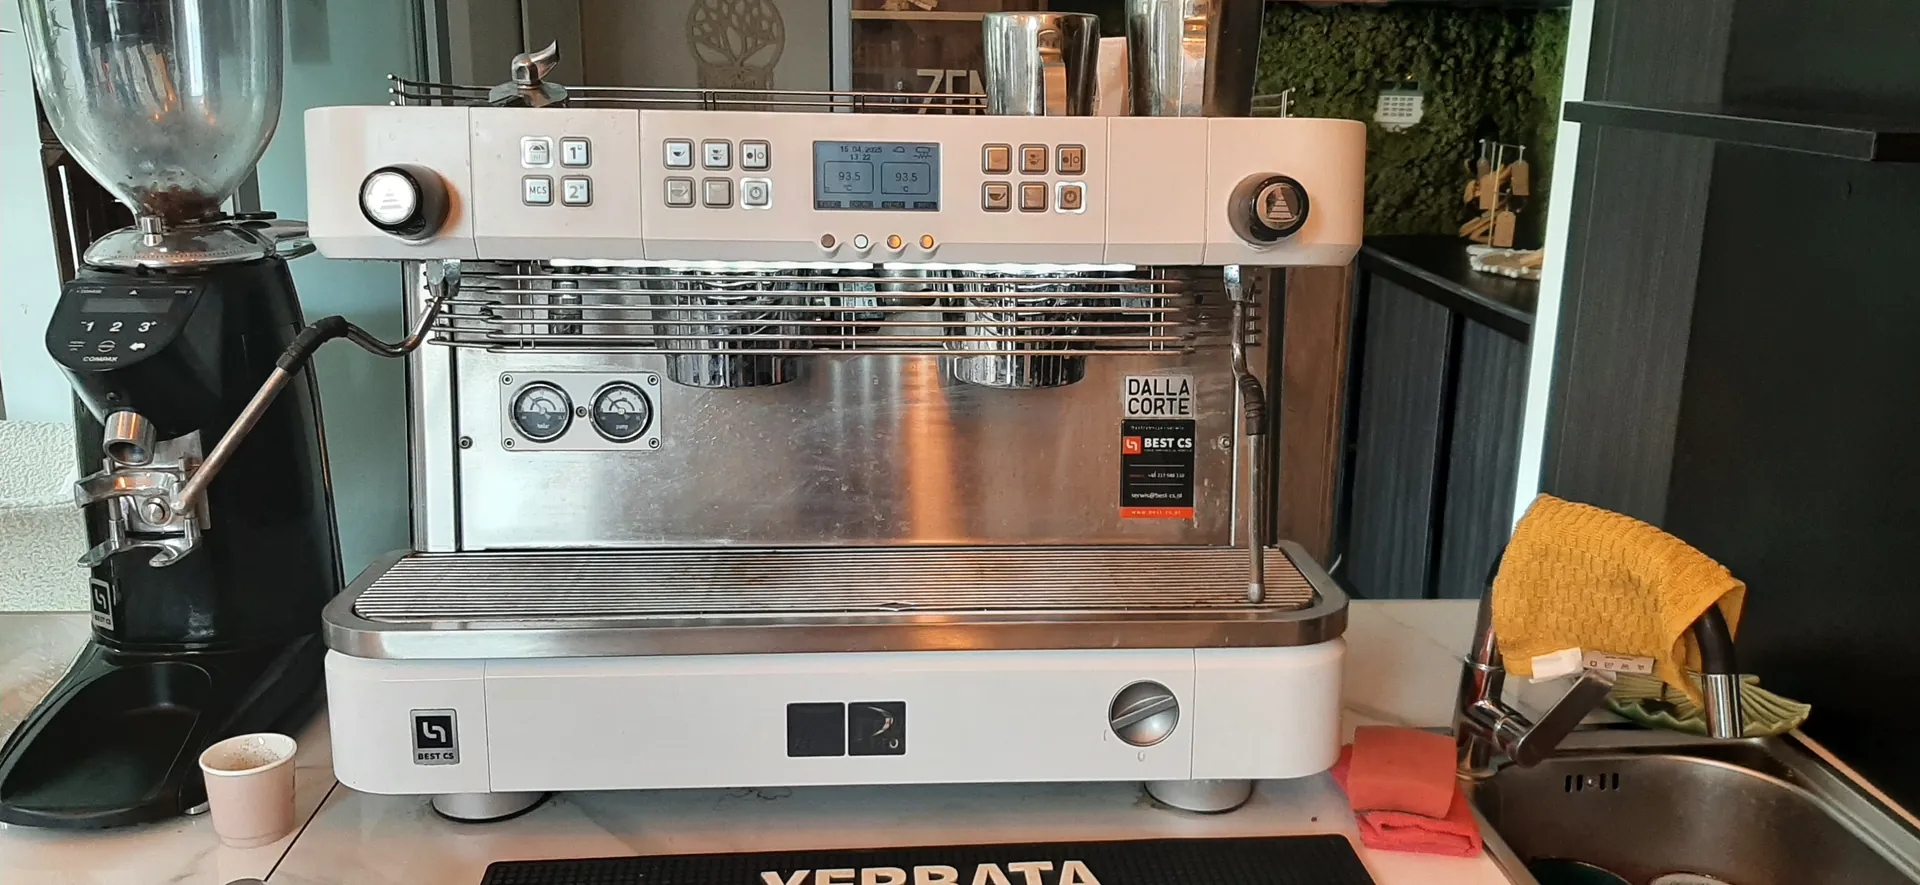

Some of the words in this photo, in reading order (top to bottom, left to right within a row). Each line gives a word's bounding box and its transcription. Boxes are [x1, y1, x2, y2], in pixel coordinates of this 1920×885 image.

[838, 171, 861, 181] 93.5
[895, 172, 918, 182] 93.5
[529, 186, 547, 195] MCS
[109, 321, 123, 332] 2
[1128, 378, 1190, 396] DALLA
[1128, 398, 1190, 415] CORTE
[1144, 437, 1175, 448] BEST
[1177, 437, 1192, 448] CS
[418, 752, 440, 760] BEST
[443, 752, 454, 760] CS
